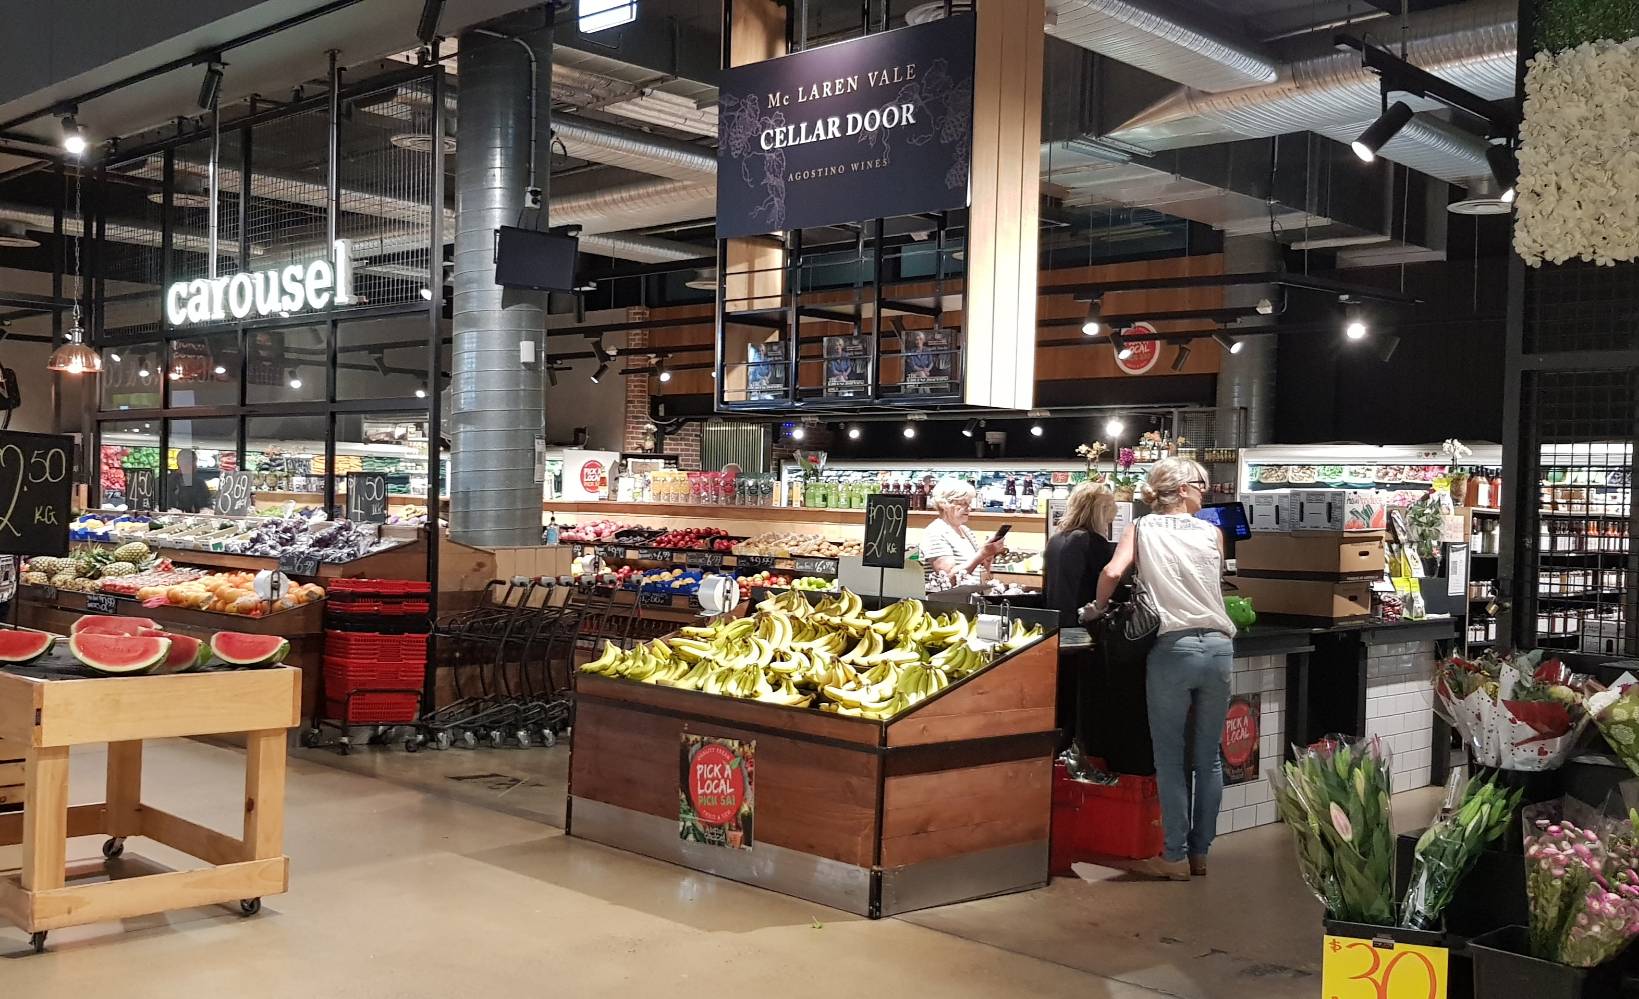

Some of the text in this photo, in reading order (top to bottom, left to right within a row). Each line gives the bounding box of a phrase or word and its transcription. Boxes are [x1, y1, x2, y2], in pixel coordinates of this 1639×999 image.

[767, 63, 917, 109] Mc LAREN VALE
[760, 103, 916, 151] CELLAR DOOR
[787, 157, 889, 183] AGOSTINO WINES
[166, 239, 350, 325] carousel
[34, 506, 58, 525] KG
[1226, 717, 1242, 733] PICK
[1226, 728, 1250, 746] LOCAL
[696, 764, 733, 779] PICK A
[697, 779, 735, 795] LOCAL
